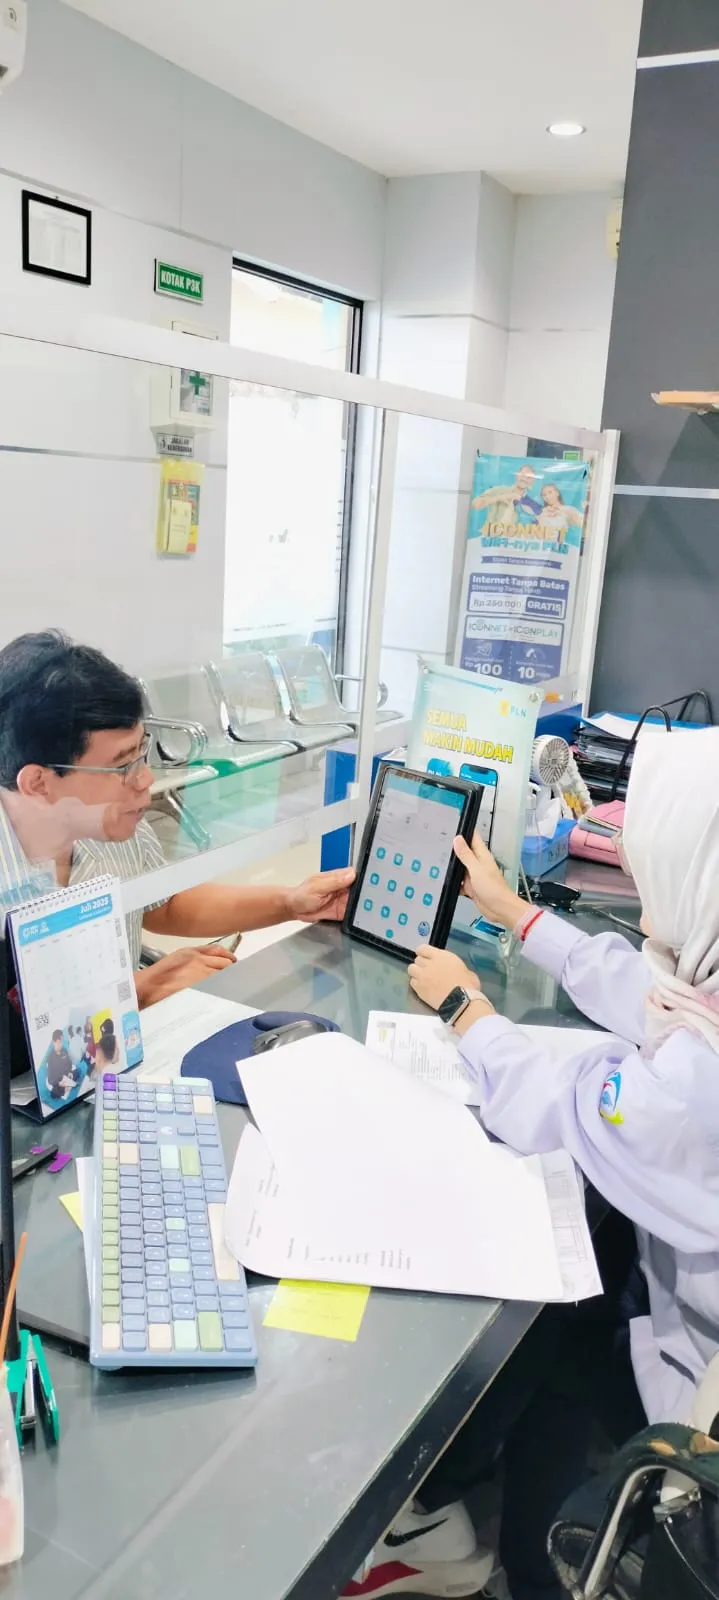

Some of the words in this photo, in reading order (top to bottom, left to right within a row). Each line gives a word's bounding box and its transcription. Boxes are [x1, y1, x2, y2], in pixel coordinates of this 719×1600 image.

[161, 270, 185, 289] KOTAK
[185, 277, 201, 294] P3K
[481, 521, 567, 545] ICONNET
[542, 541, 569, 554] PLN
[472, 575, 510, 585] Internet
[511, 577, 539, 588] Tanpa
[539, 580, 566, 590] Batas
[527, 600, 562, 612] GRATIS
[468, 622, 507, 632] ICONNET
[474, 663, 503, 676] 100
[517, 666, 536, 679] 10
[510, 705, 527, 717] PLN
[426, 709, 468, 732] SEMUA
[422, 730, 464, 753] MAKIN
[463, 736, 514, 764] MUDAH
